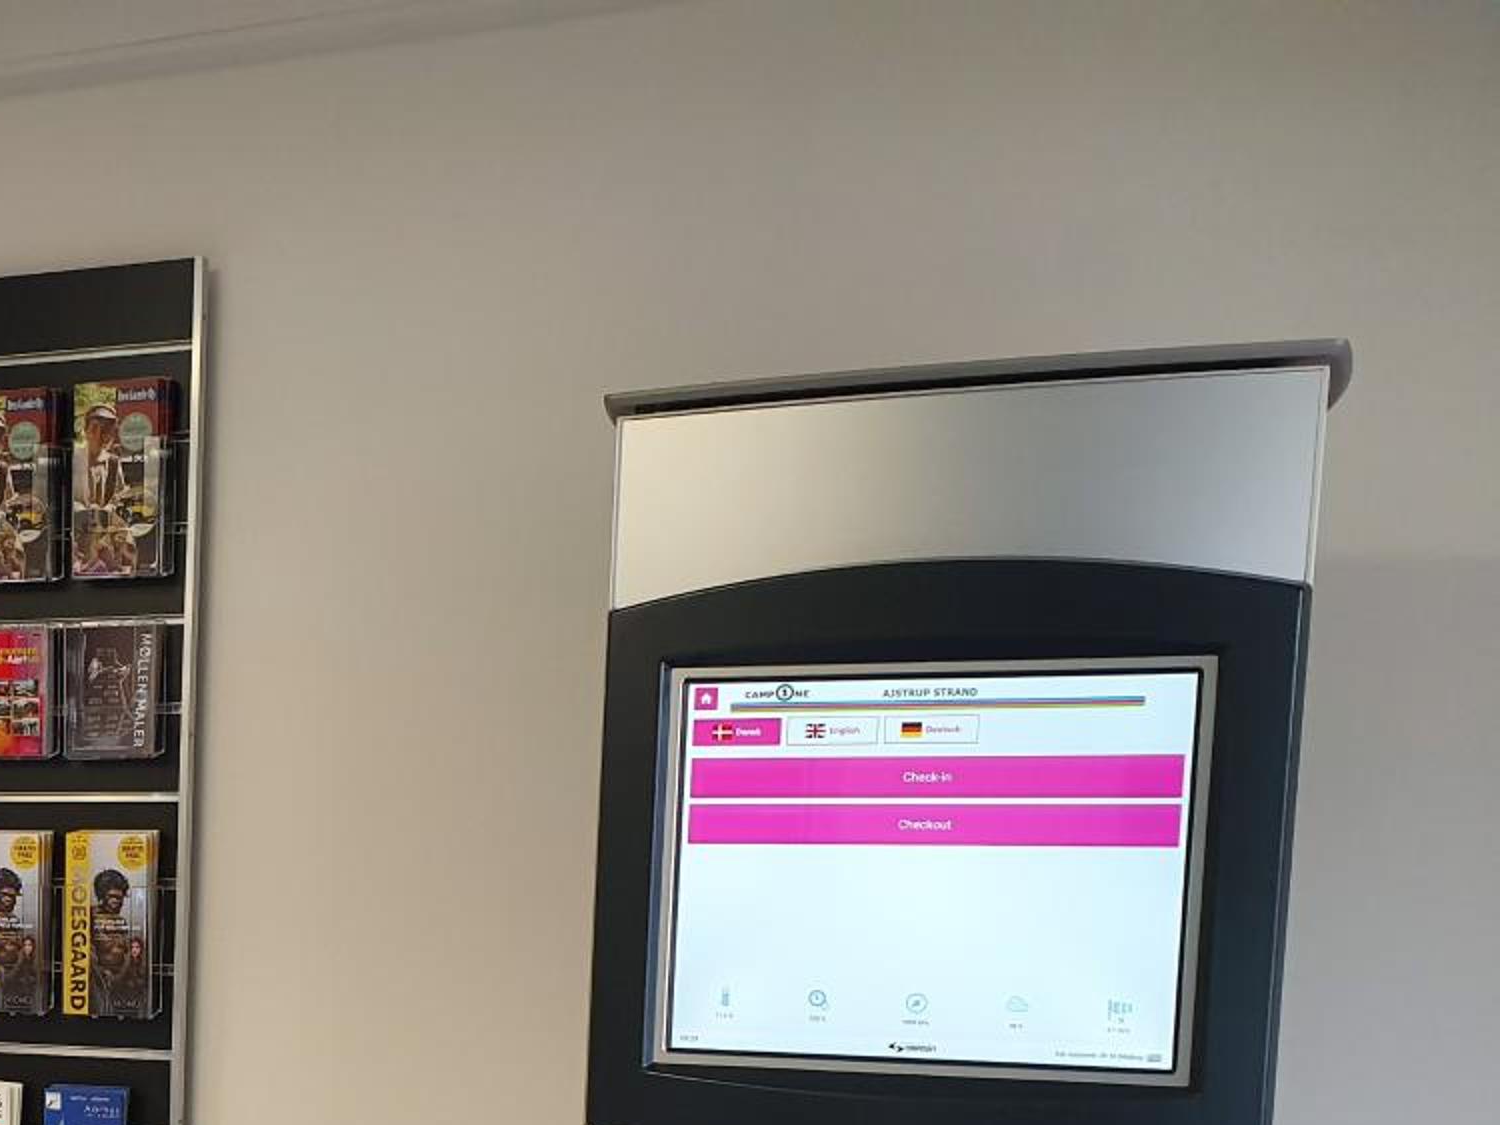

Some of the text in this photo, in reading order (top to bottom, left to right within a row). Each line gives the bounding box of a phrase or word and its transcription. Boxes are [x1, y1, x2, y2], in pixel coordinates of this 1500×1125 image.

[882, 687, 979, 699] AJSTRUP STRAND
[829, 726, 861, 737] English
[902, 771, 953, 784] Check-in
[898, 818, 953, 832] Checkout
